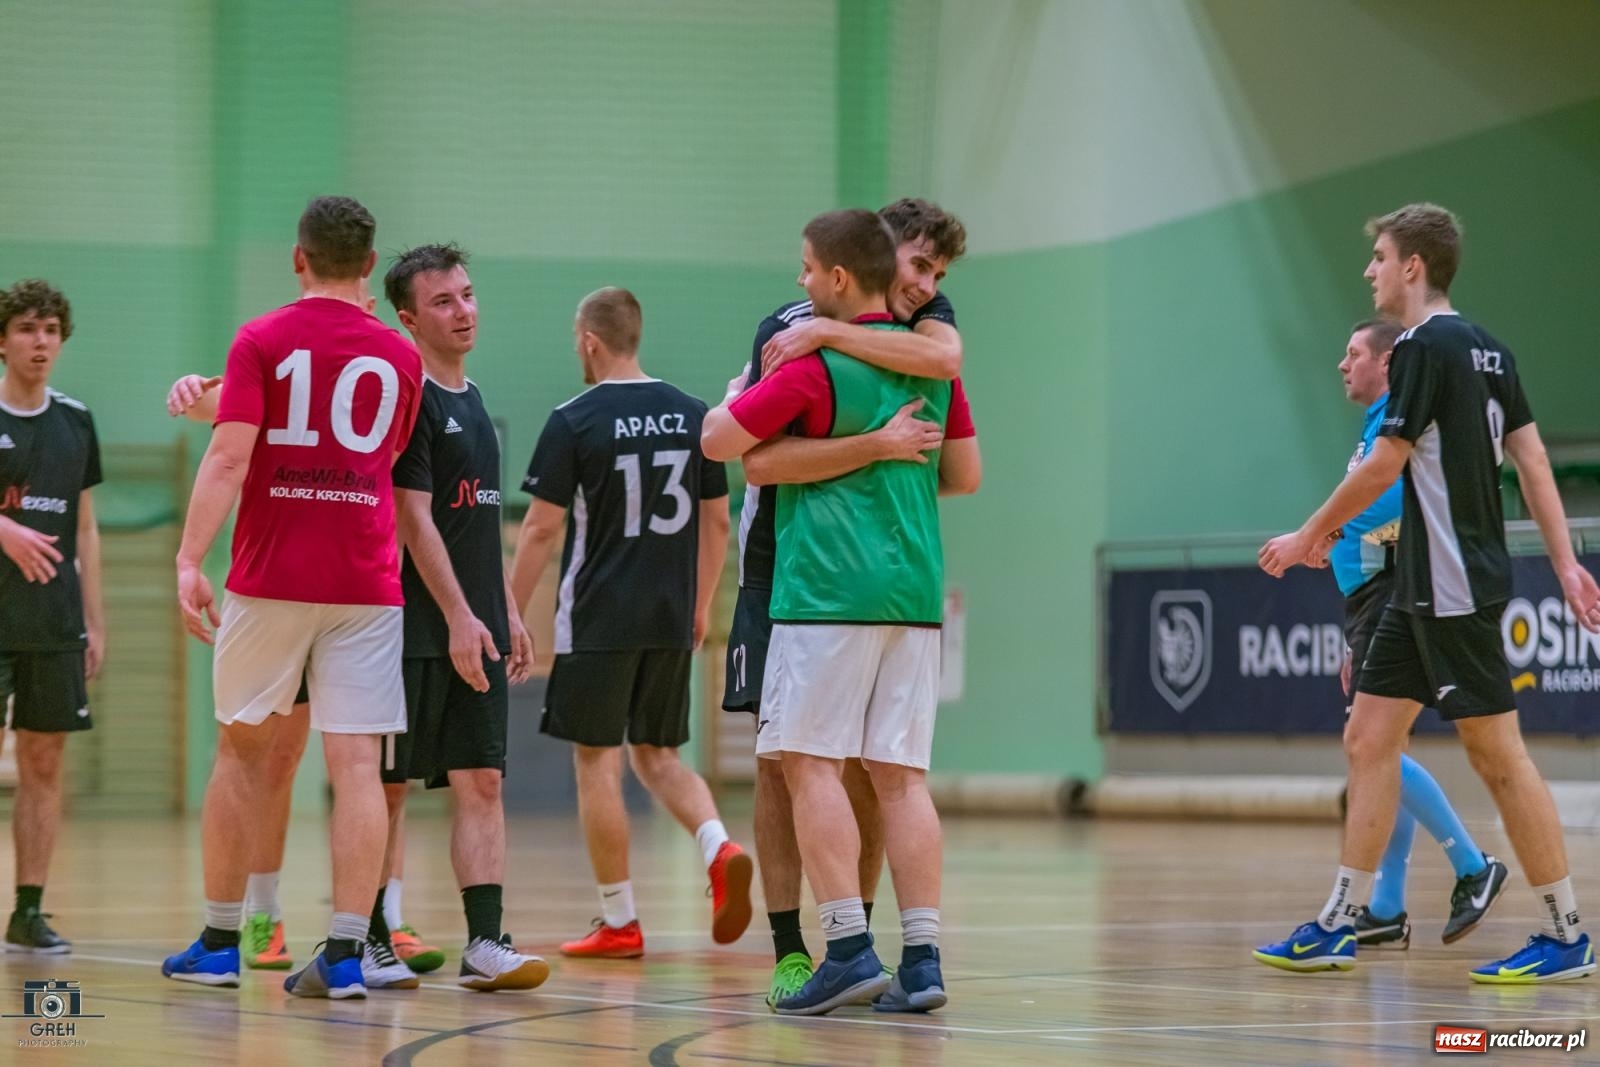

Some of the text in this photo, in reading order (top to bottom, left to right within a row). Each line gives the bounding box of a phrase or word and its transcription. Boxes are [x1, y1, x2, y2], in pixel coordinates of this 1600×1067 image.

[267, 348, 400, 454] 10
[614, 413, 689, 439] APACZ
[269, 486, 315, 500] KOLORZ
[614, 449, 693, 538] 13
[1239, 622, 1348, 677] RACIB
